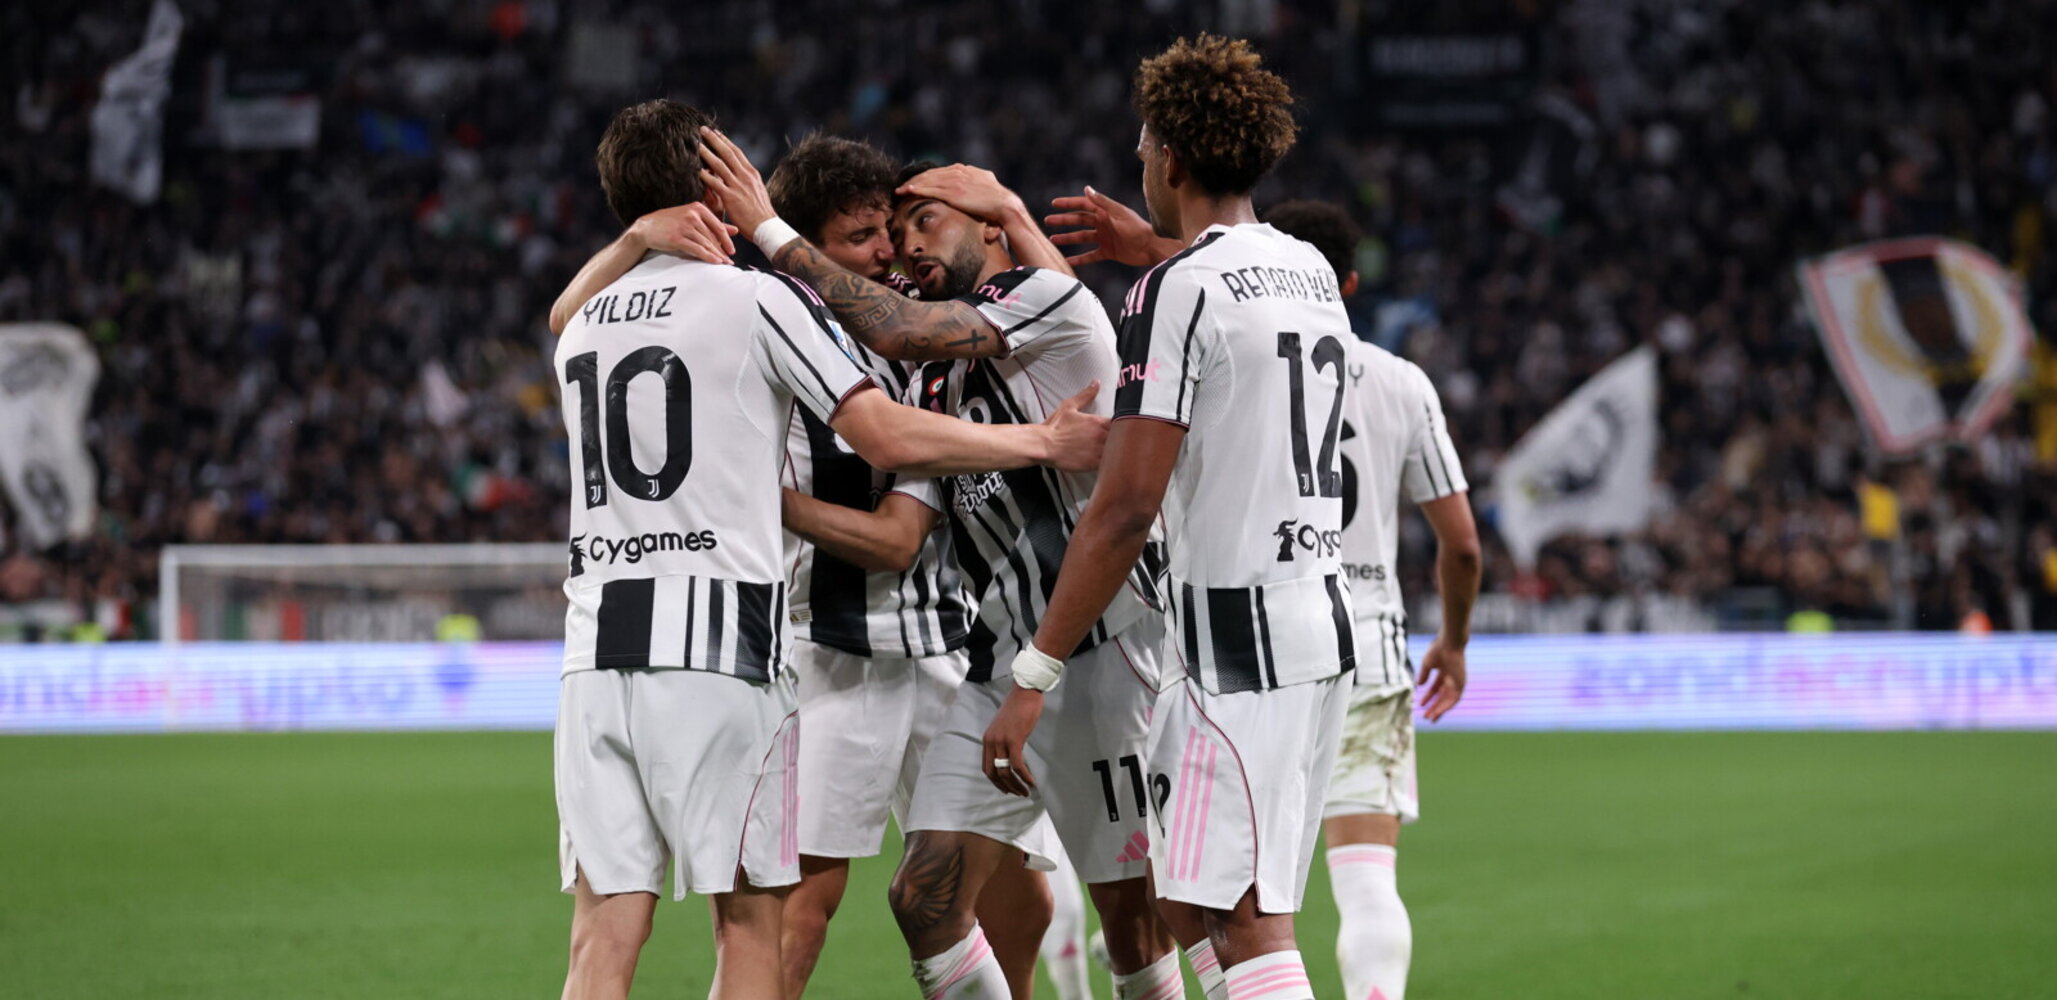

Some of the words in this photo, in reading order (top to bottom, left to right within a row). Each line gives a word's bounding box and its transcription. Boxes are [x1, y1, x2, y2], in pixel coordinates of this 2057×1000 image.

[1220, 265, 1308, 302] RENATO
[583, 286, 677, 326] YILDIZ
[565, 345, 692, 510] 10
[1277, 332, 1345, 498] 12
[589, 529, 718, 564] Cygames
[1340, 562, 1386, 581] mes
[1092, 754, 1147, 823] 11
